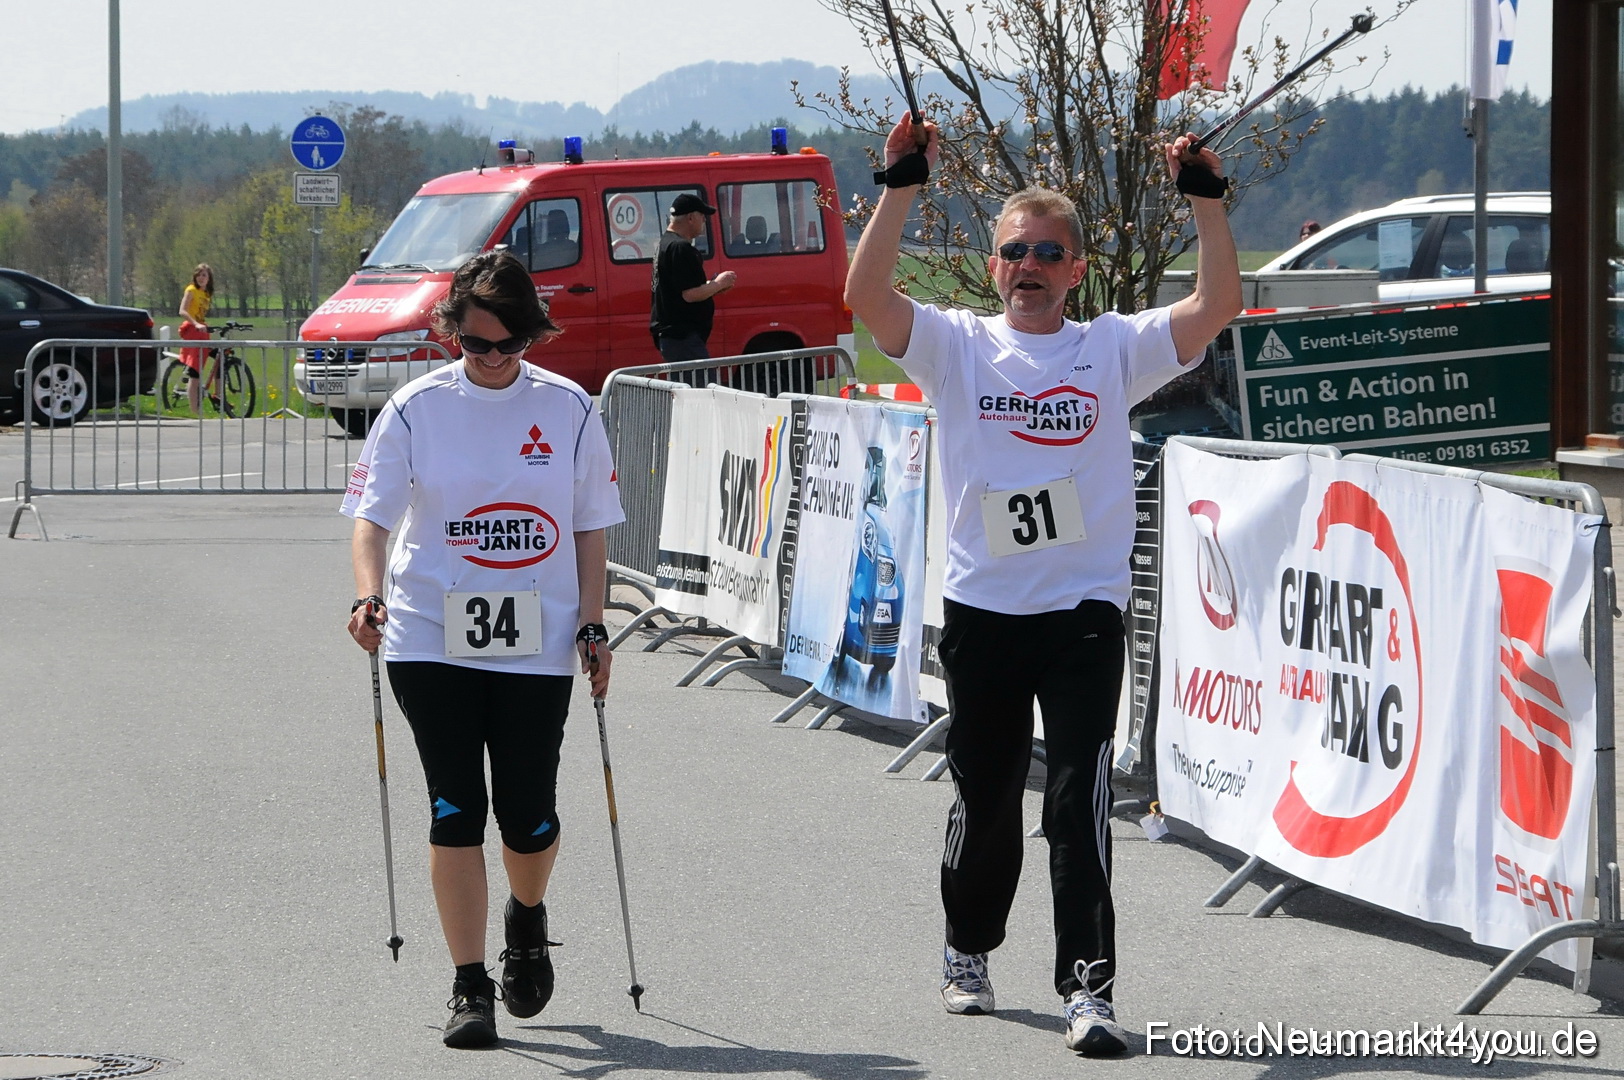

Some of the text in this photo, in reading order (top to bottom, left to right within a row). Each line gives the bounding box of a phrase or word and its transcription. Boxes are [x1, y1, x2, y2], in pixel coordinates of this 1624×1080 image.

[615, 206, 635, 224] 60
[1300, 325, 1459, 350] Event-Leit-Systeme
[1259, 367, 1469, 408] Fun & Action in
[979, 395, 1092, 416] GERHART &
[979, 412, 1092, 430] Autohaus JÄNIG
[1262, 397, 1497, 440] sicheren Bahnen!
[1436, 443, 1484, 462] 09181
[1490, 439, 1531, 456] 6352
[535, 522, 544, 533] &
[1008, 488, 1058, 546] 31
[478, 534, 547, 551] JÄNIG
[466, 596, 520, 649] 34
[1387, 607, 1402, 663] &
[1183, 666, 1263, 735] MOTORS
[1494, 853, 1575, 921] SEAT
